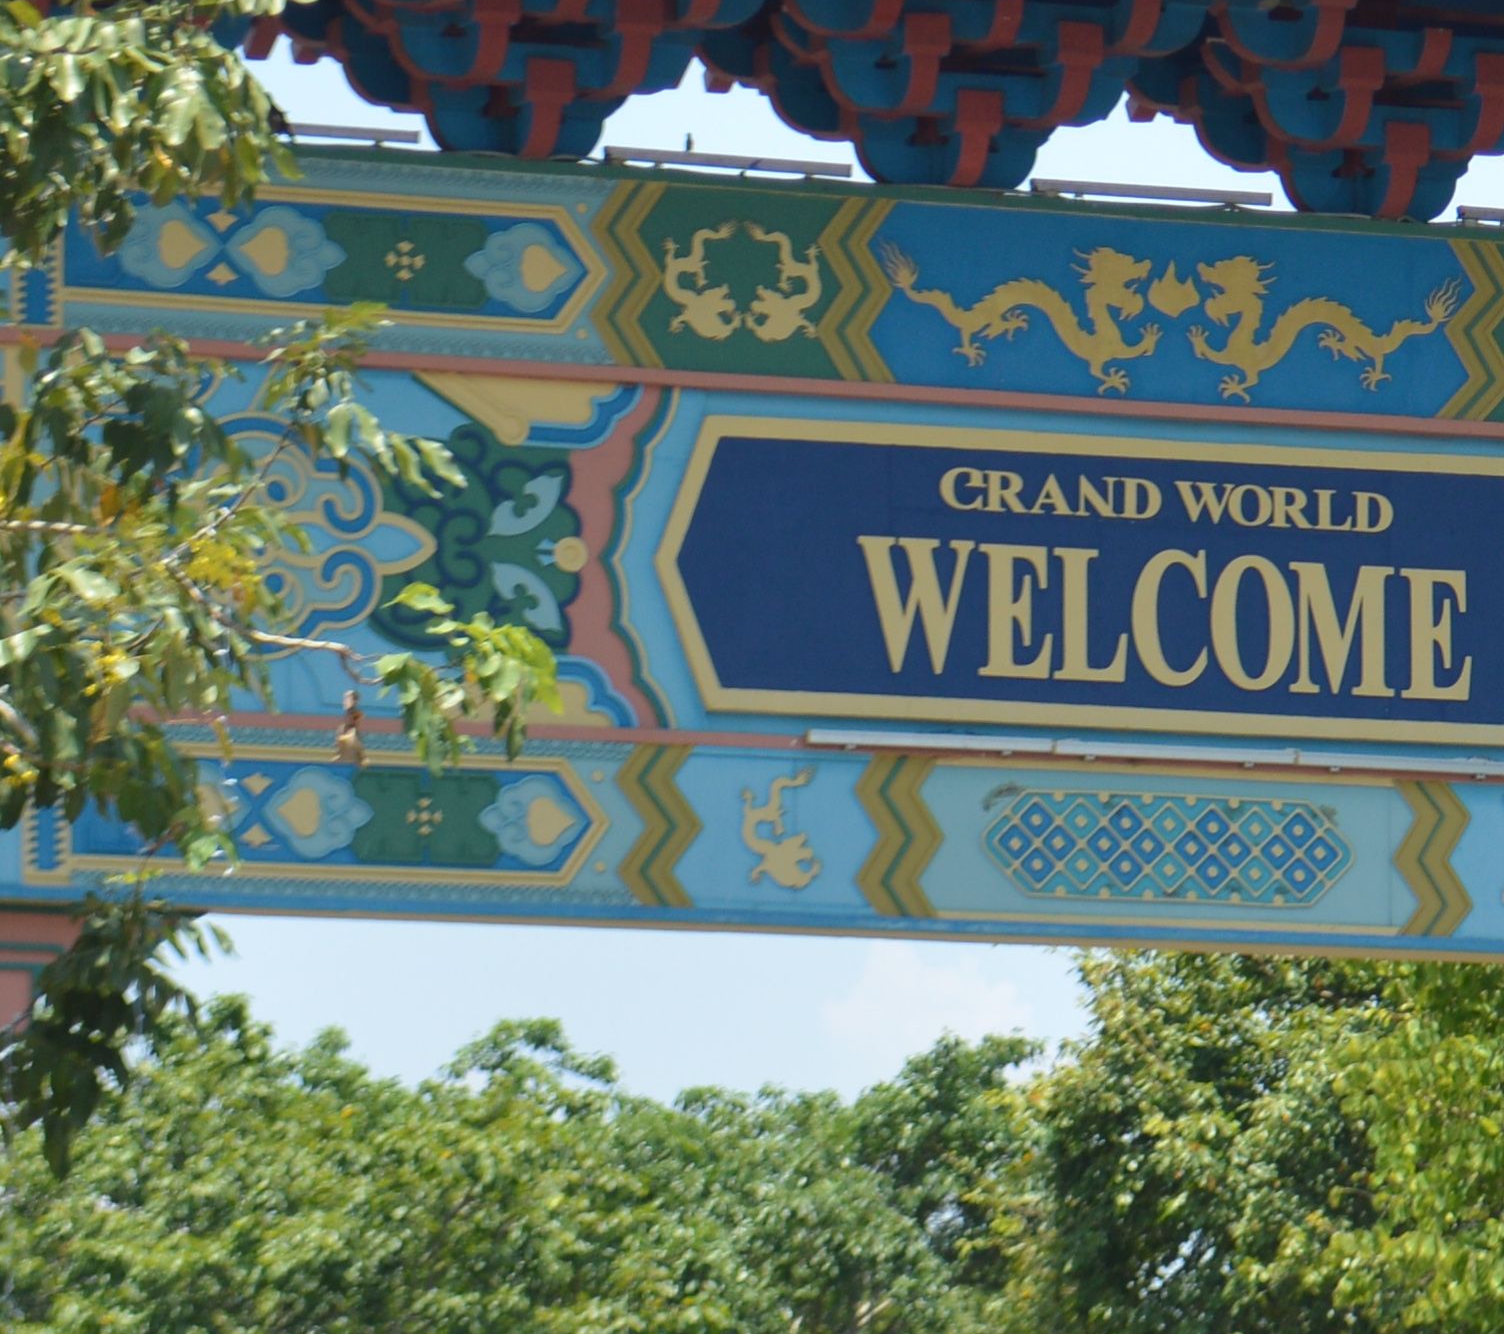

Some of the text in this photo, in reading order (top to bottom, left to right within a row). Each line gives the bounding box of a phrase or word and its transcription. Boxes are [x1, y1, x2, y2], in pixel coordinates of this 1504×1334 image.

[938, 466, 1395, 534] GRAND WORLD
[856, 535, 1472, 702] WELCOME
